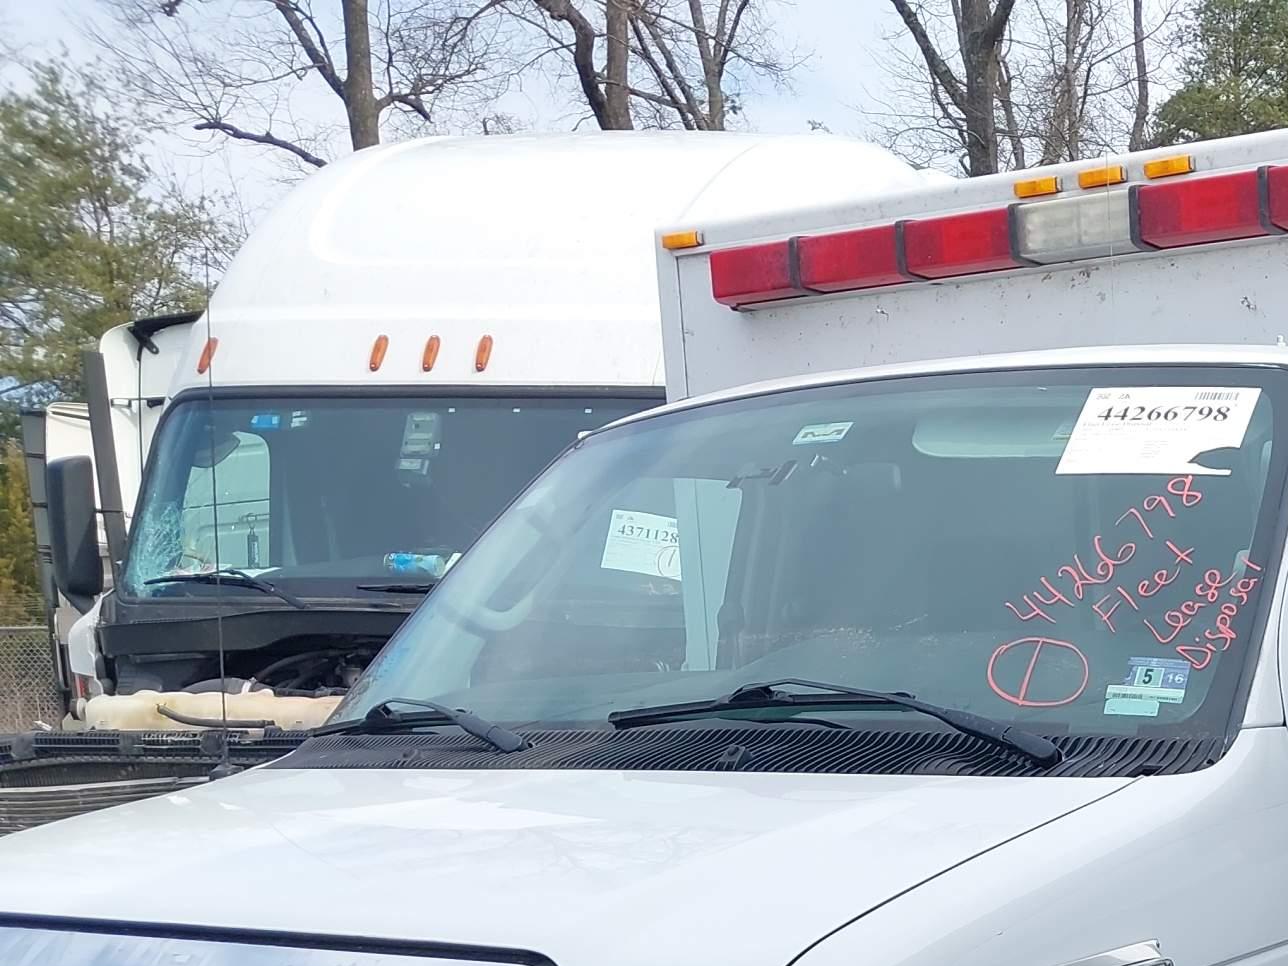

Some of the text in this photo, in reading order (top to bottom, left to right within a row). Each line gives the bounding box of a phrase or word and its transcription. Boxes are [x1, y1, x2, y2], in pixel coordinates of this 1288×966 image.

[1097, 405, 1231, 422] 44266798
[1004, 474, 1203, 624] 44266798
[1092, 540, 1195, 633] Fleet
[1143, 569, 1237, 644] Lease
[1142, 668, 1154, 684] 5
[1167, 672, 1185, 684] 16
